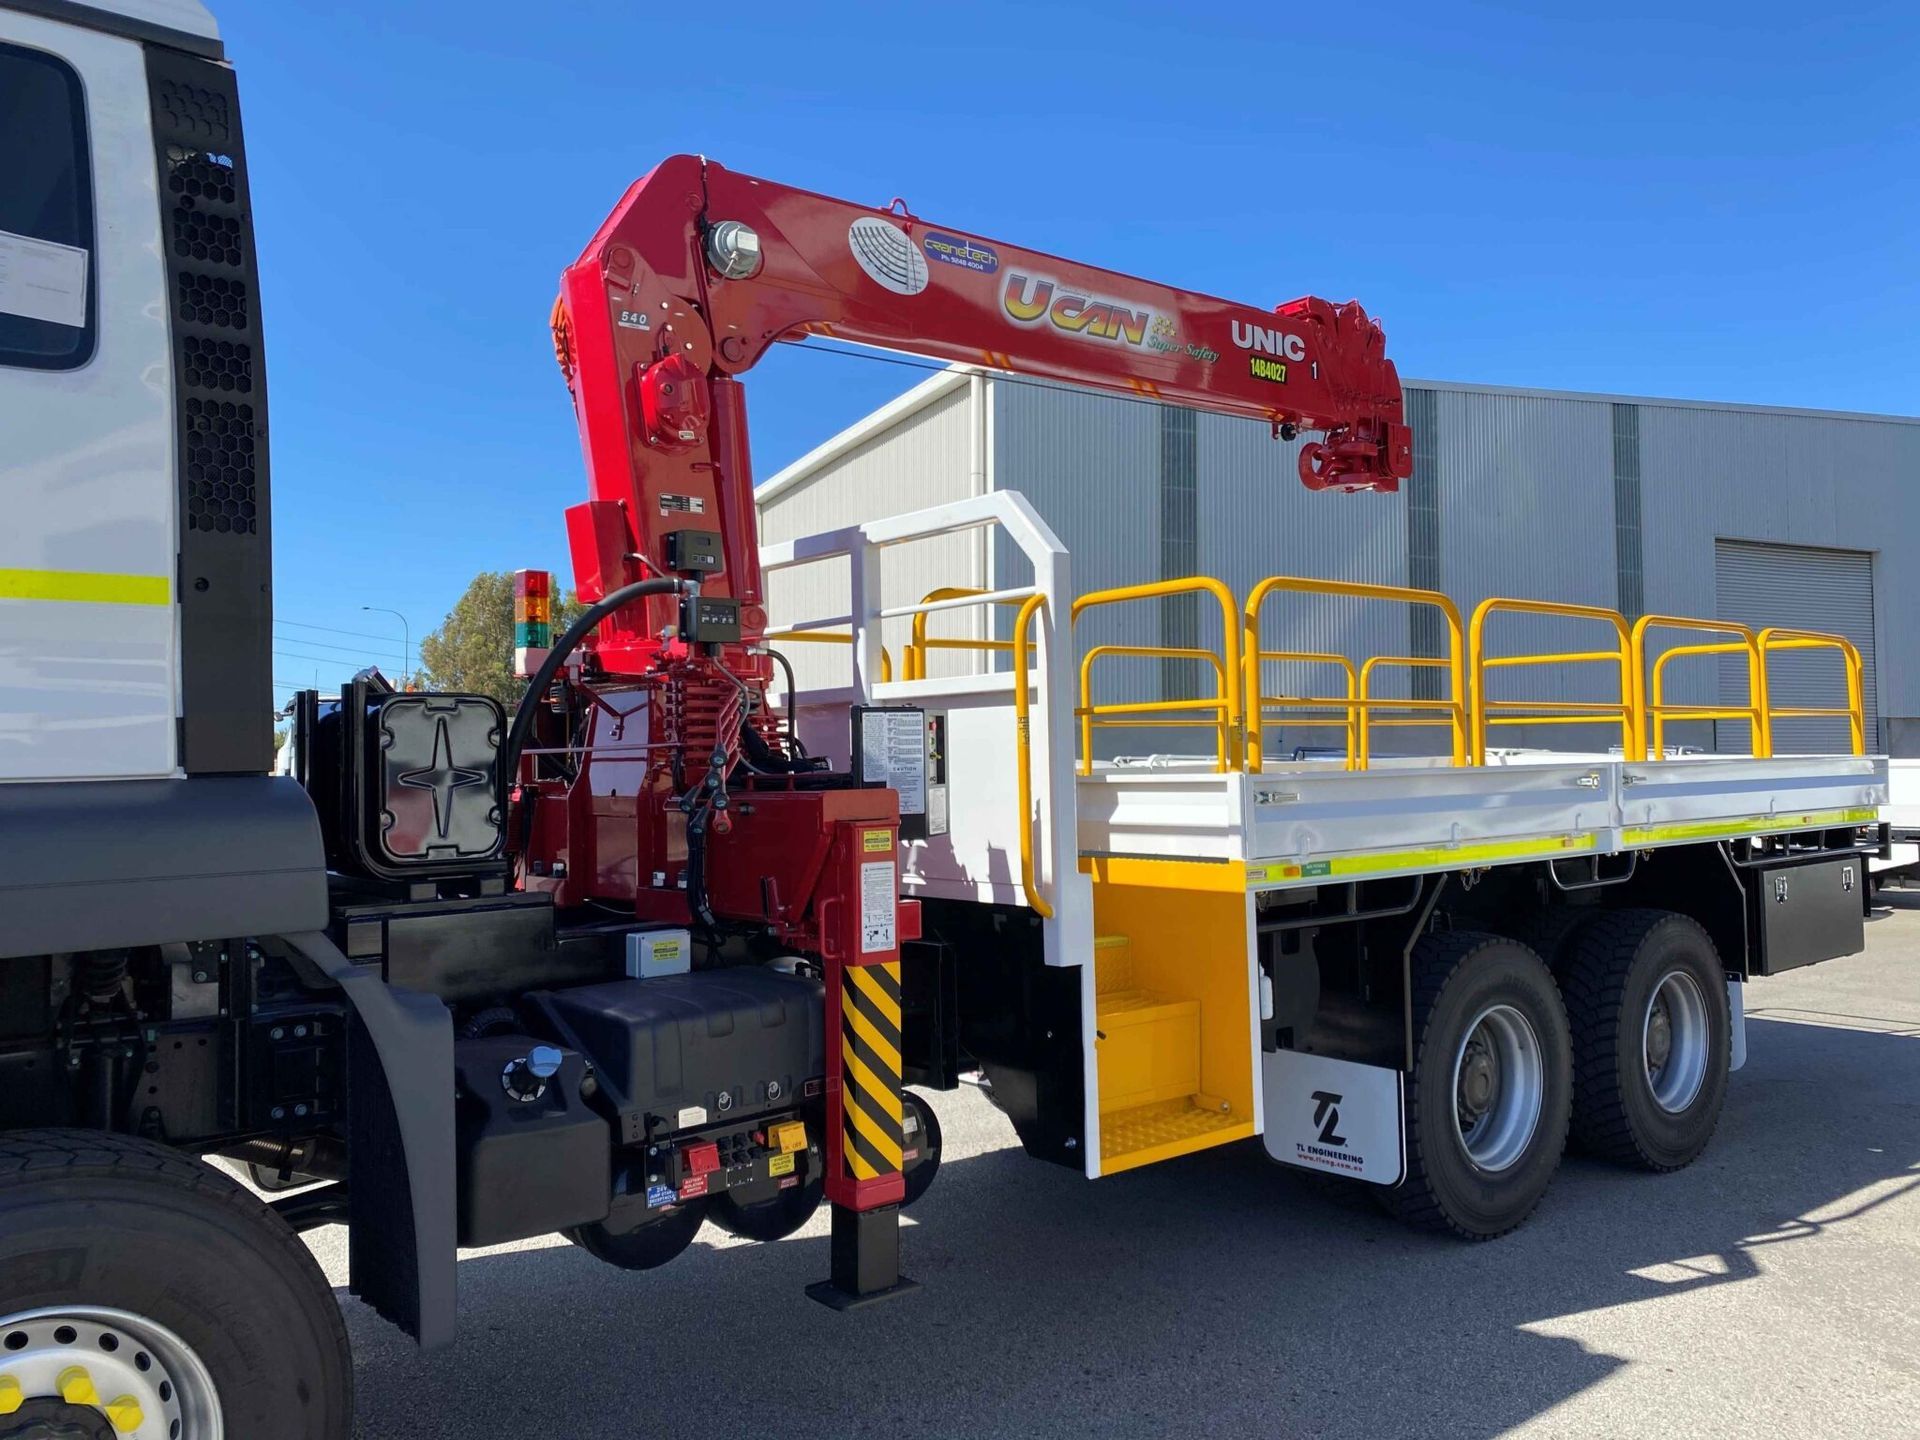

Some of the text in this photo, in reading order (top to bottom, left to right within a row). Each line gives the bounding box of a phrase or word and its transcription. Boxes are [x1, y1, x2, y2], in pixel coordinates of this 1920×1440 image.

[967, 260, 984, 271] 4004
[621, 311, 647, 325] 540
[1004, 274, 1149, 346] UCAN
[1147, 335, 1220, 363] Super Safety
[1231, 320, 1305, 362] UNIC
[1250, 358, 1287, 383] 14B4027
[1312, 361, 1318, 380] 1
[1296, 1143, 1364, 1165] TL ENGINEERING
